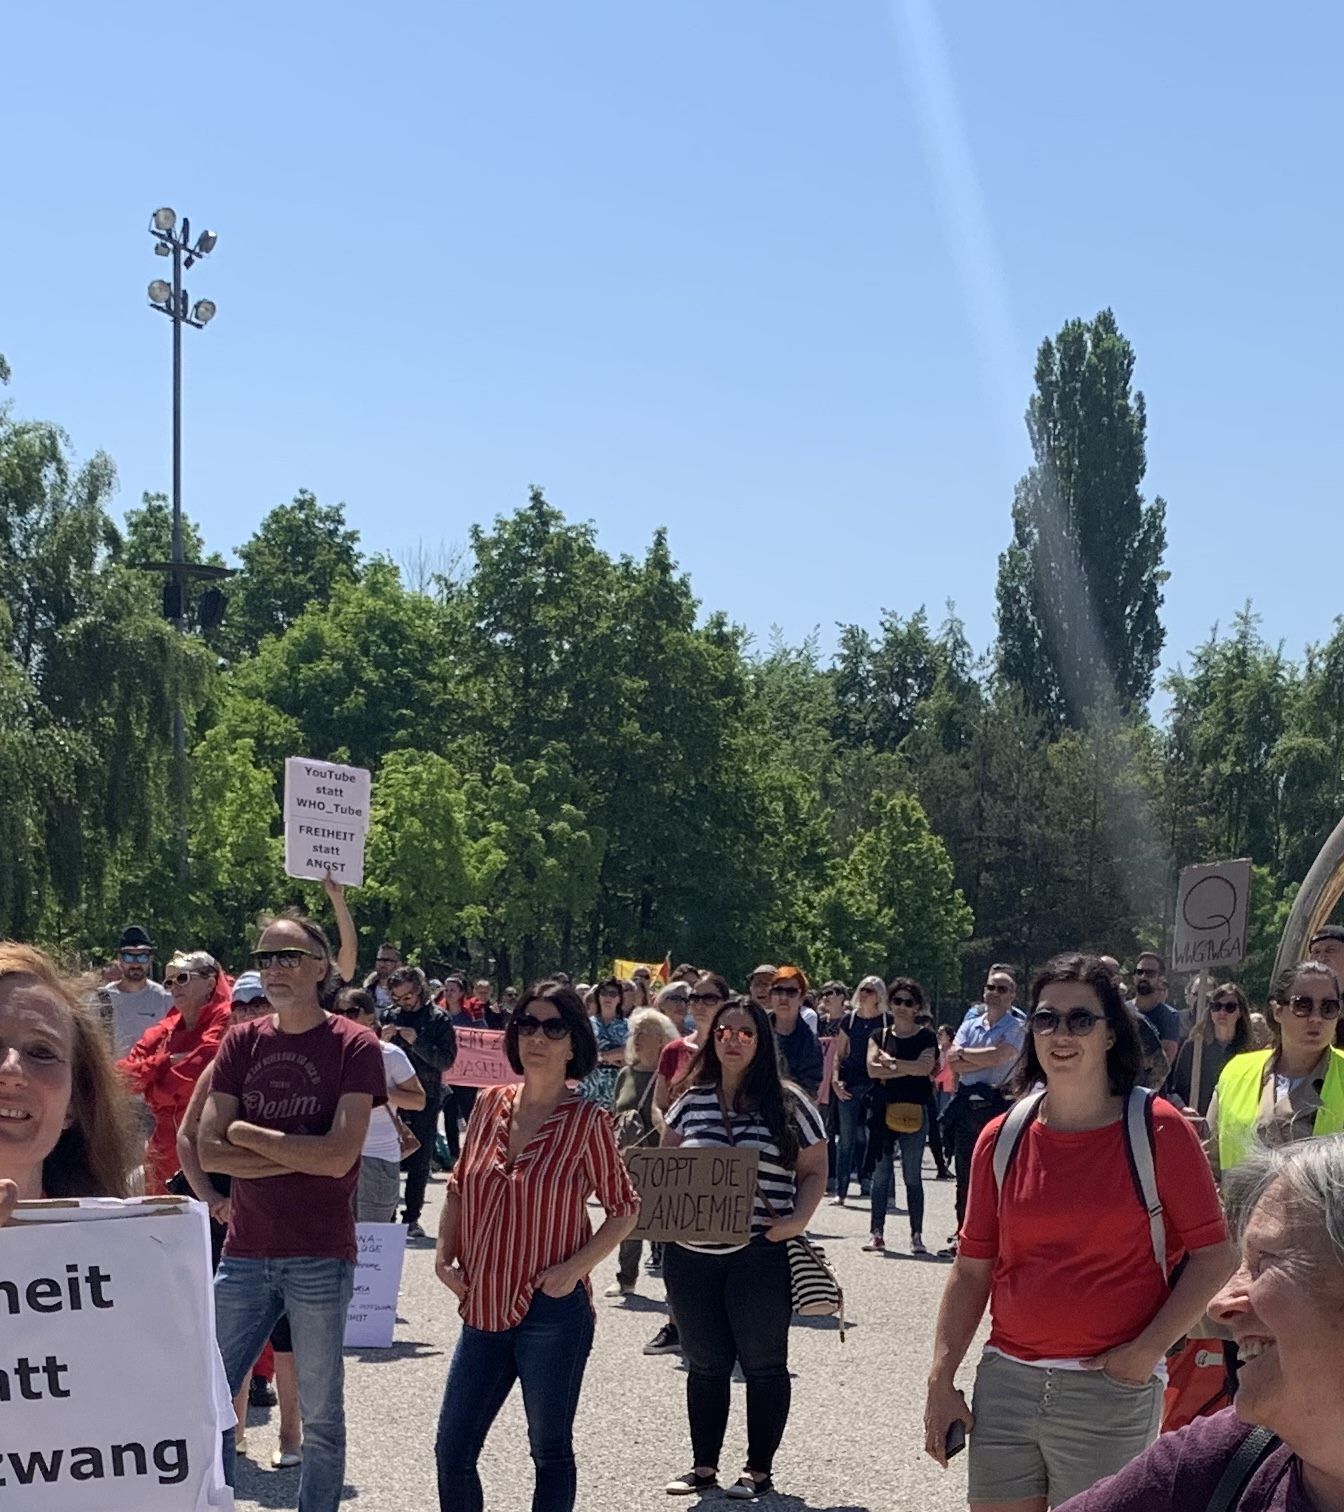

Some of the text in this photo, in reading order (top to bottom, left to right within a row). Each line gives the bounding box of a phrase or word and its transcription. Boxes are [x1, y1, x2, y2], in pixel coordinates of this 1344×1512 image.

[305, 766, 357, 784] YouTube
[315, 786, 344, 798] statt
[296, 798, 363, 817] WHO_Tube
[299, 825, 356, 842] FREIHEIT
[312, 843, 341, 856] statt
[306, 858, 346, 872] ANGST
[1183, 875, 1237, 938] Q
[242, 1091, 321, 1119] Denim
[627, 1154, 741, 1188] STOPPT DIE
[637, 1168, 755, 1234] LANDEMIE!
